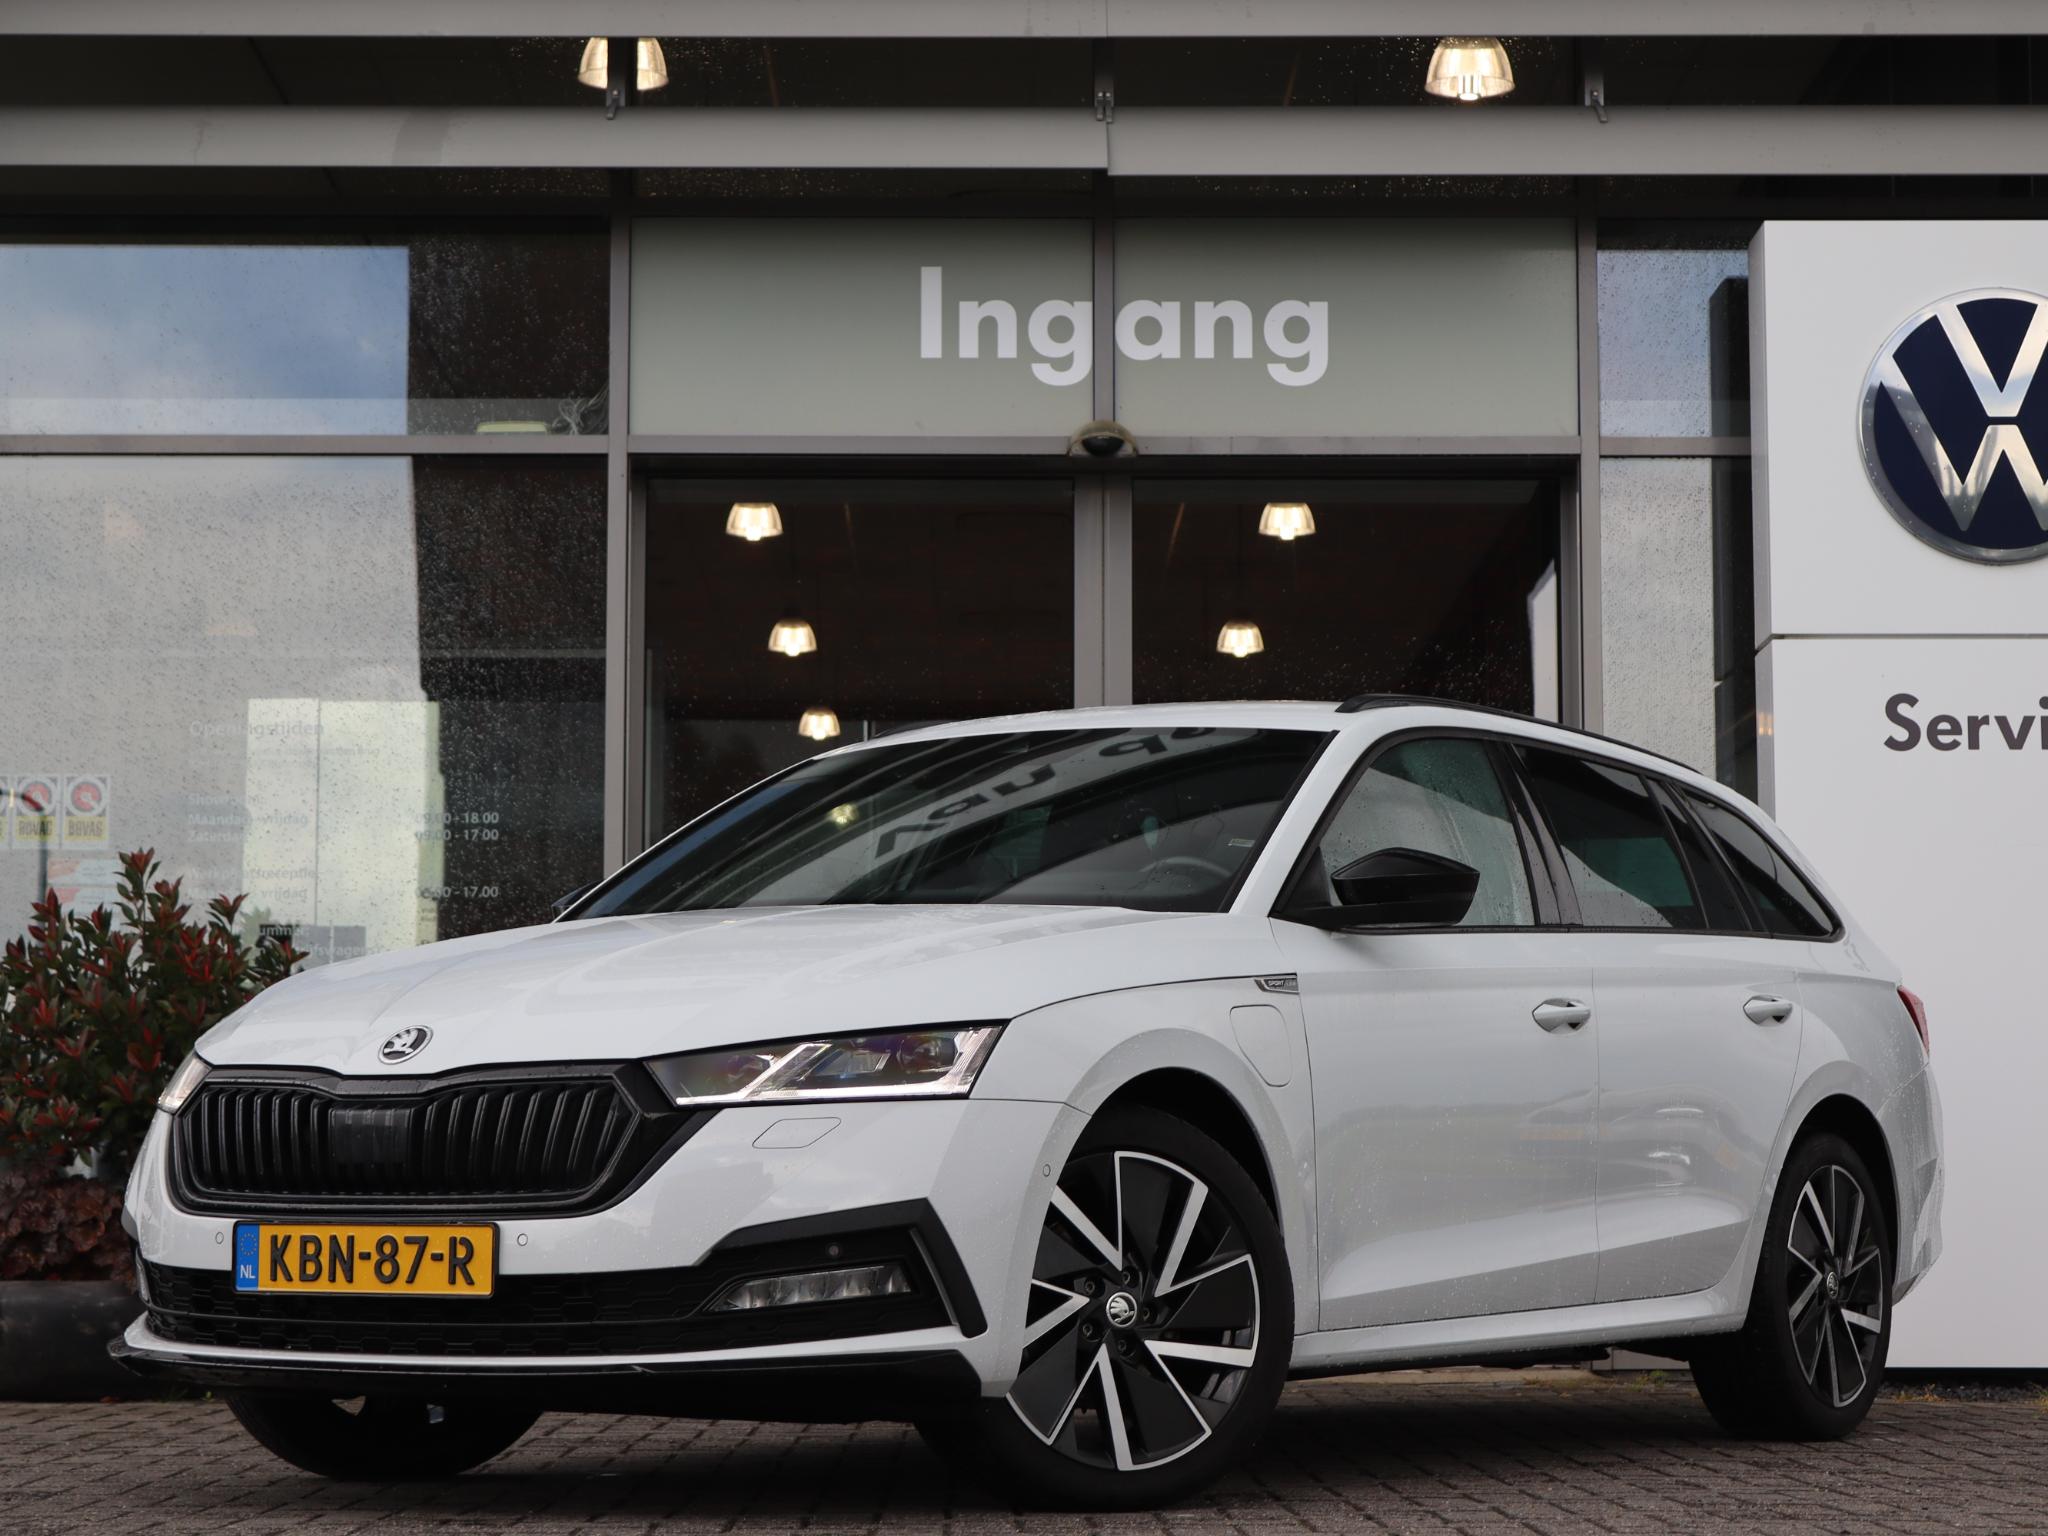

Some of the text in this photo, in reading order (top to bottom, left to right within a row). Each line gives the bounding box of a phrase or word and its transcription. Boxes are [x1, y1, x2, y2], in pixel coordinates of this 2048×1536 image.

[920, 266, 1329, 386] Ingang
[1883, 692, 2048, 752] Servi
[463, 812, 499, 824] 18.00
[463, 829, 499, 840] 17.00
[463, 886, 499, 898] 17.00
[270, 1234, 475, 1286] KBN-87-R
[240, 1264, 256, 1279] NL
